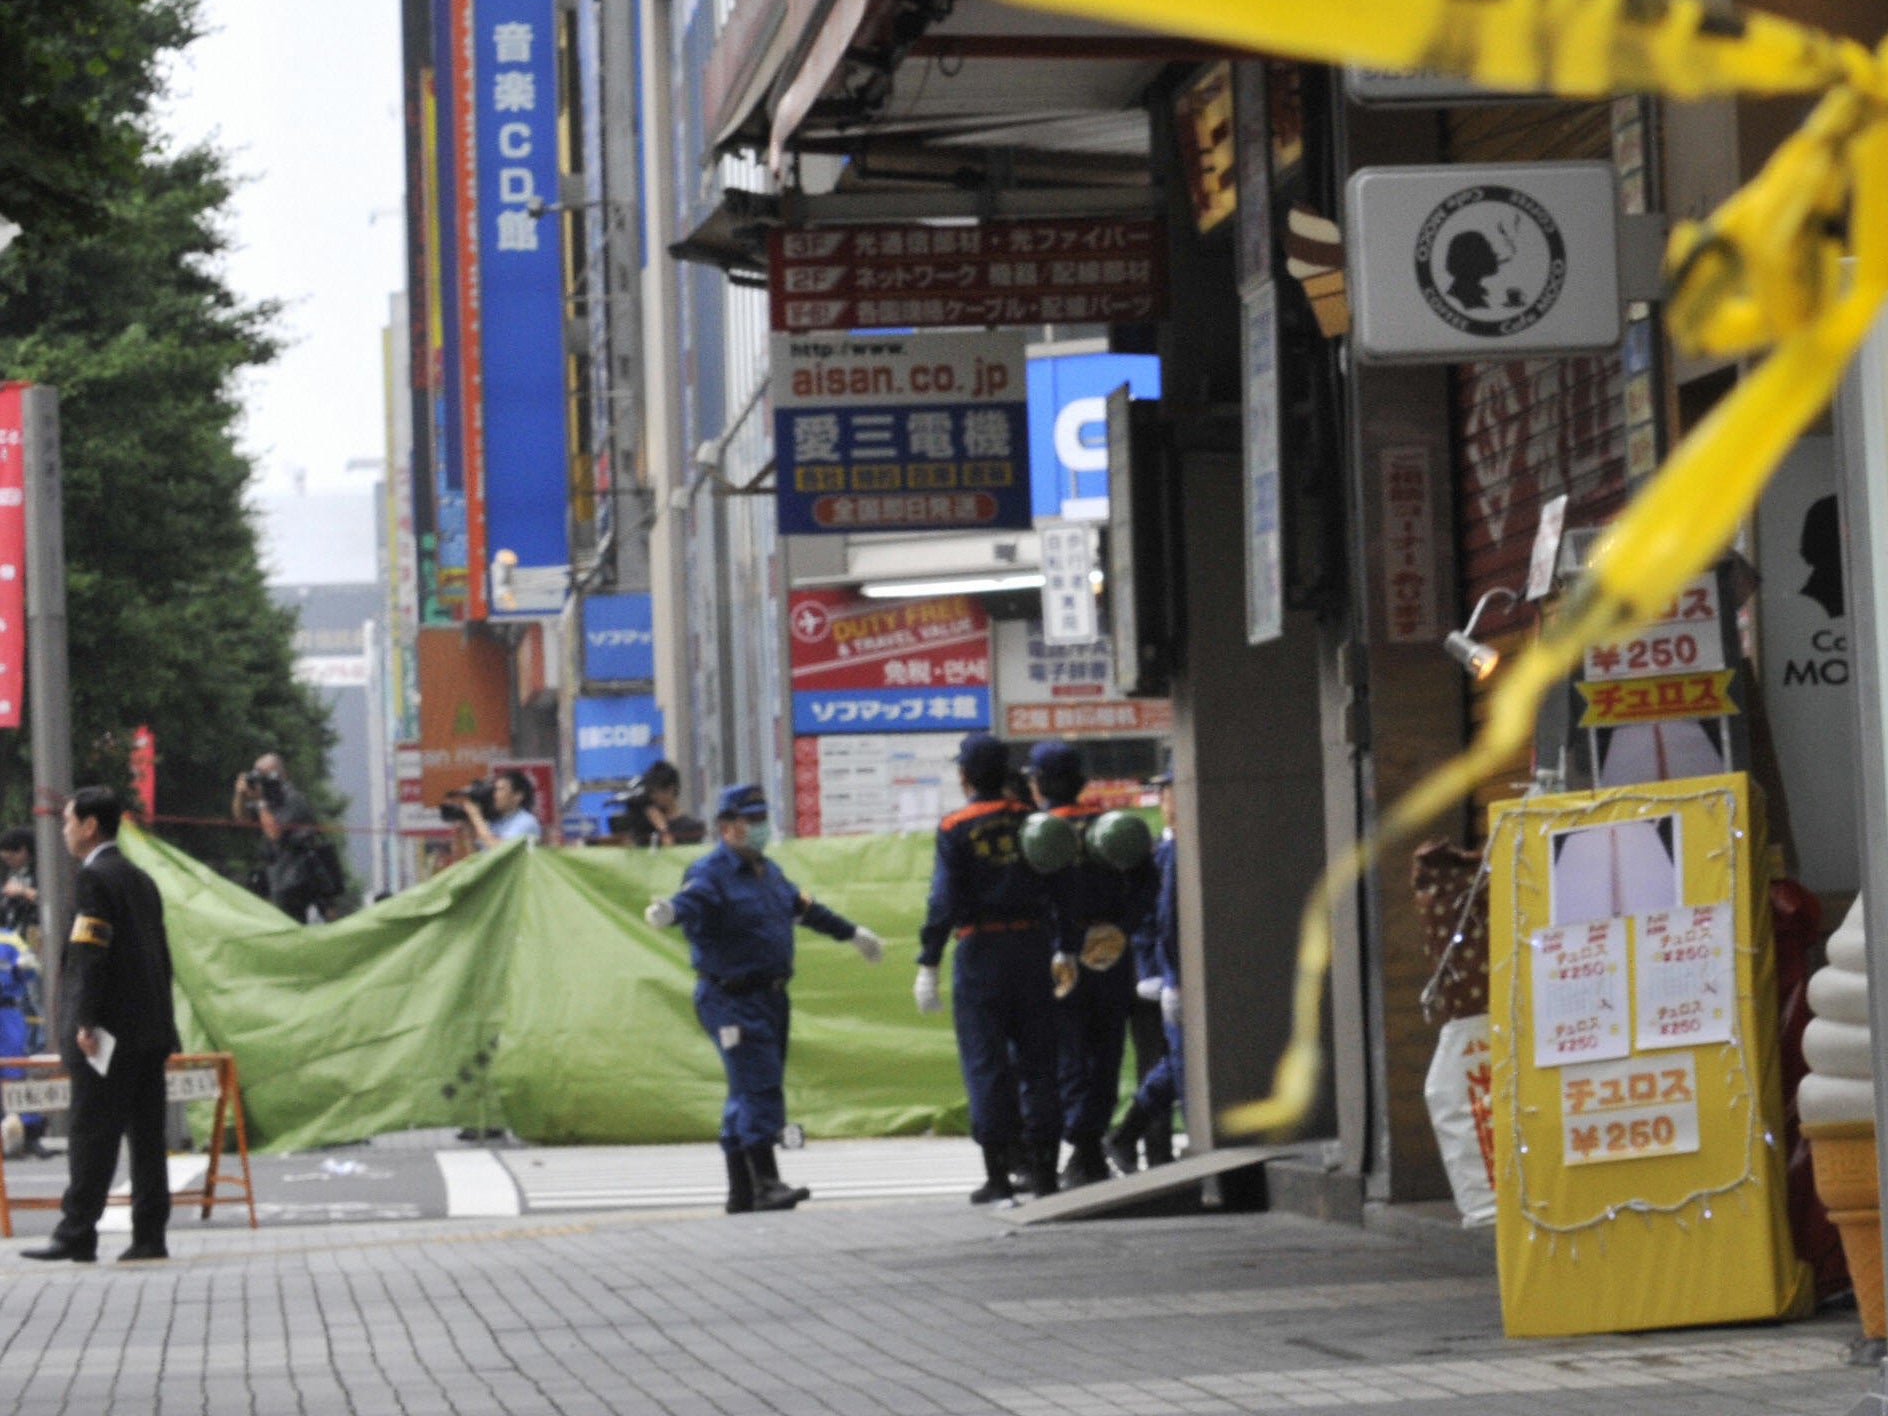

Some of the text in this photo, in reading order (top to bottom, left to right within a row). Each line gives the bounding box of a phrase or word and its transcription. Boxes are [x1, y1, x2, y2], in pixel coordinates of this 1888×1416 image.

[832, 611, 898, 644] DUTY
[1591, 634, 1698, 673] ¥250
[1593, 676, 1722, 716] チュロス
[1558, 961, 1605, 981] ¥250
[1662, 944, 1710, 963] ¥250
[1564, 1067, 1695, 1107] チュロス
[1569, 1114, 1676, 1158] ¥250
